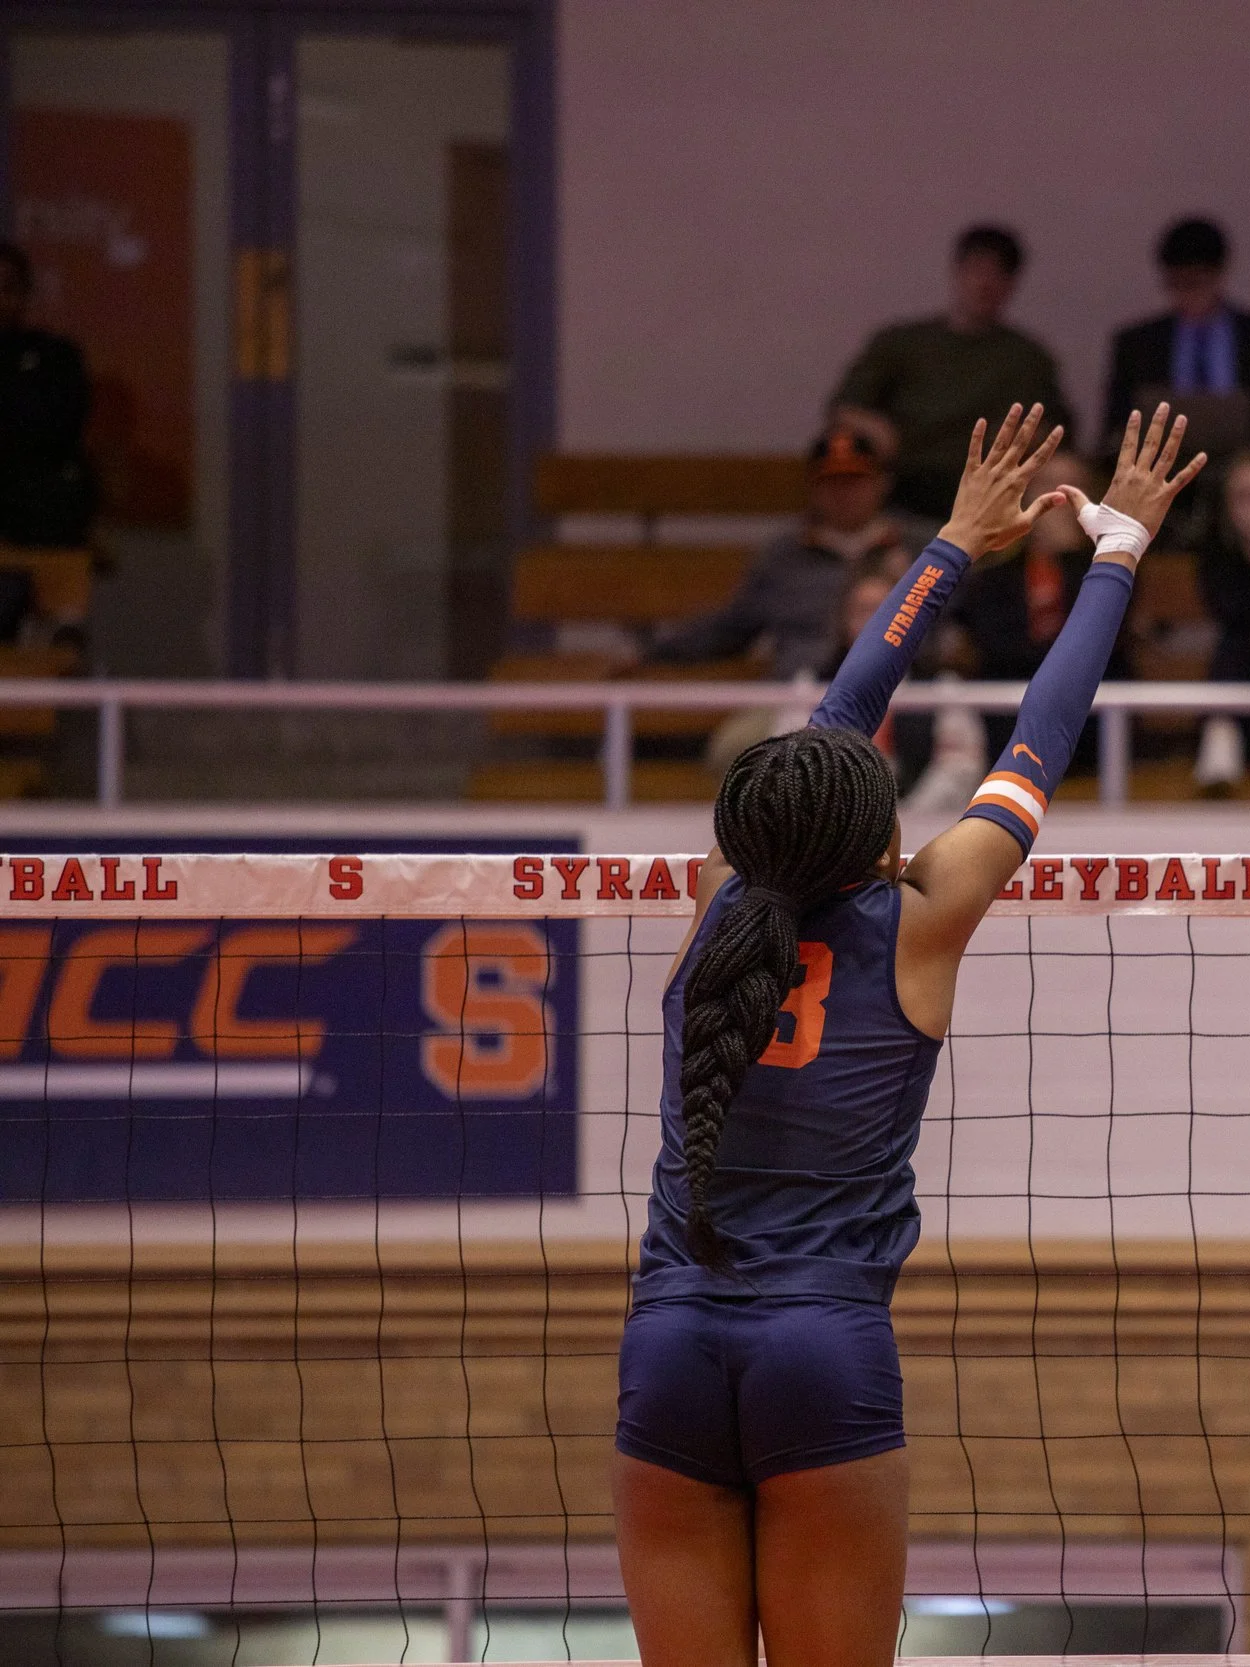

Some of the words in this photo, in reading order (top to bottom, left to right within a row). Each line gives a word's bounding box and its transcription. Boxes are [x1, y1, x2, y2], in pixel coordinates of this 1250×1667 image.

[883, 564, 944, 648] SYRACUSE
[0, 857, 178, 900] BALL
[328, 856, 364, 900] S
[424, 922, 555, 1096] S
